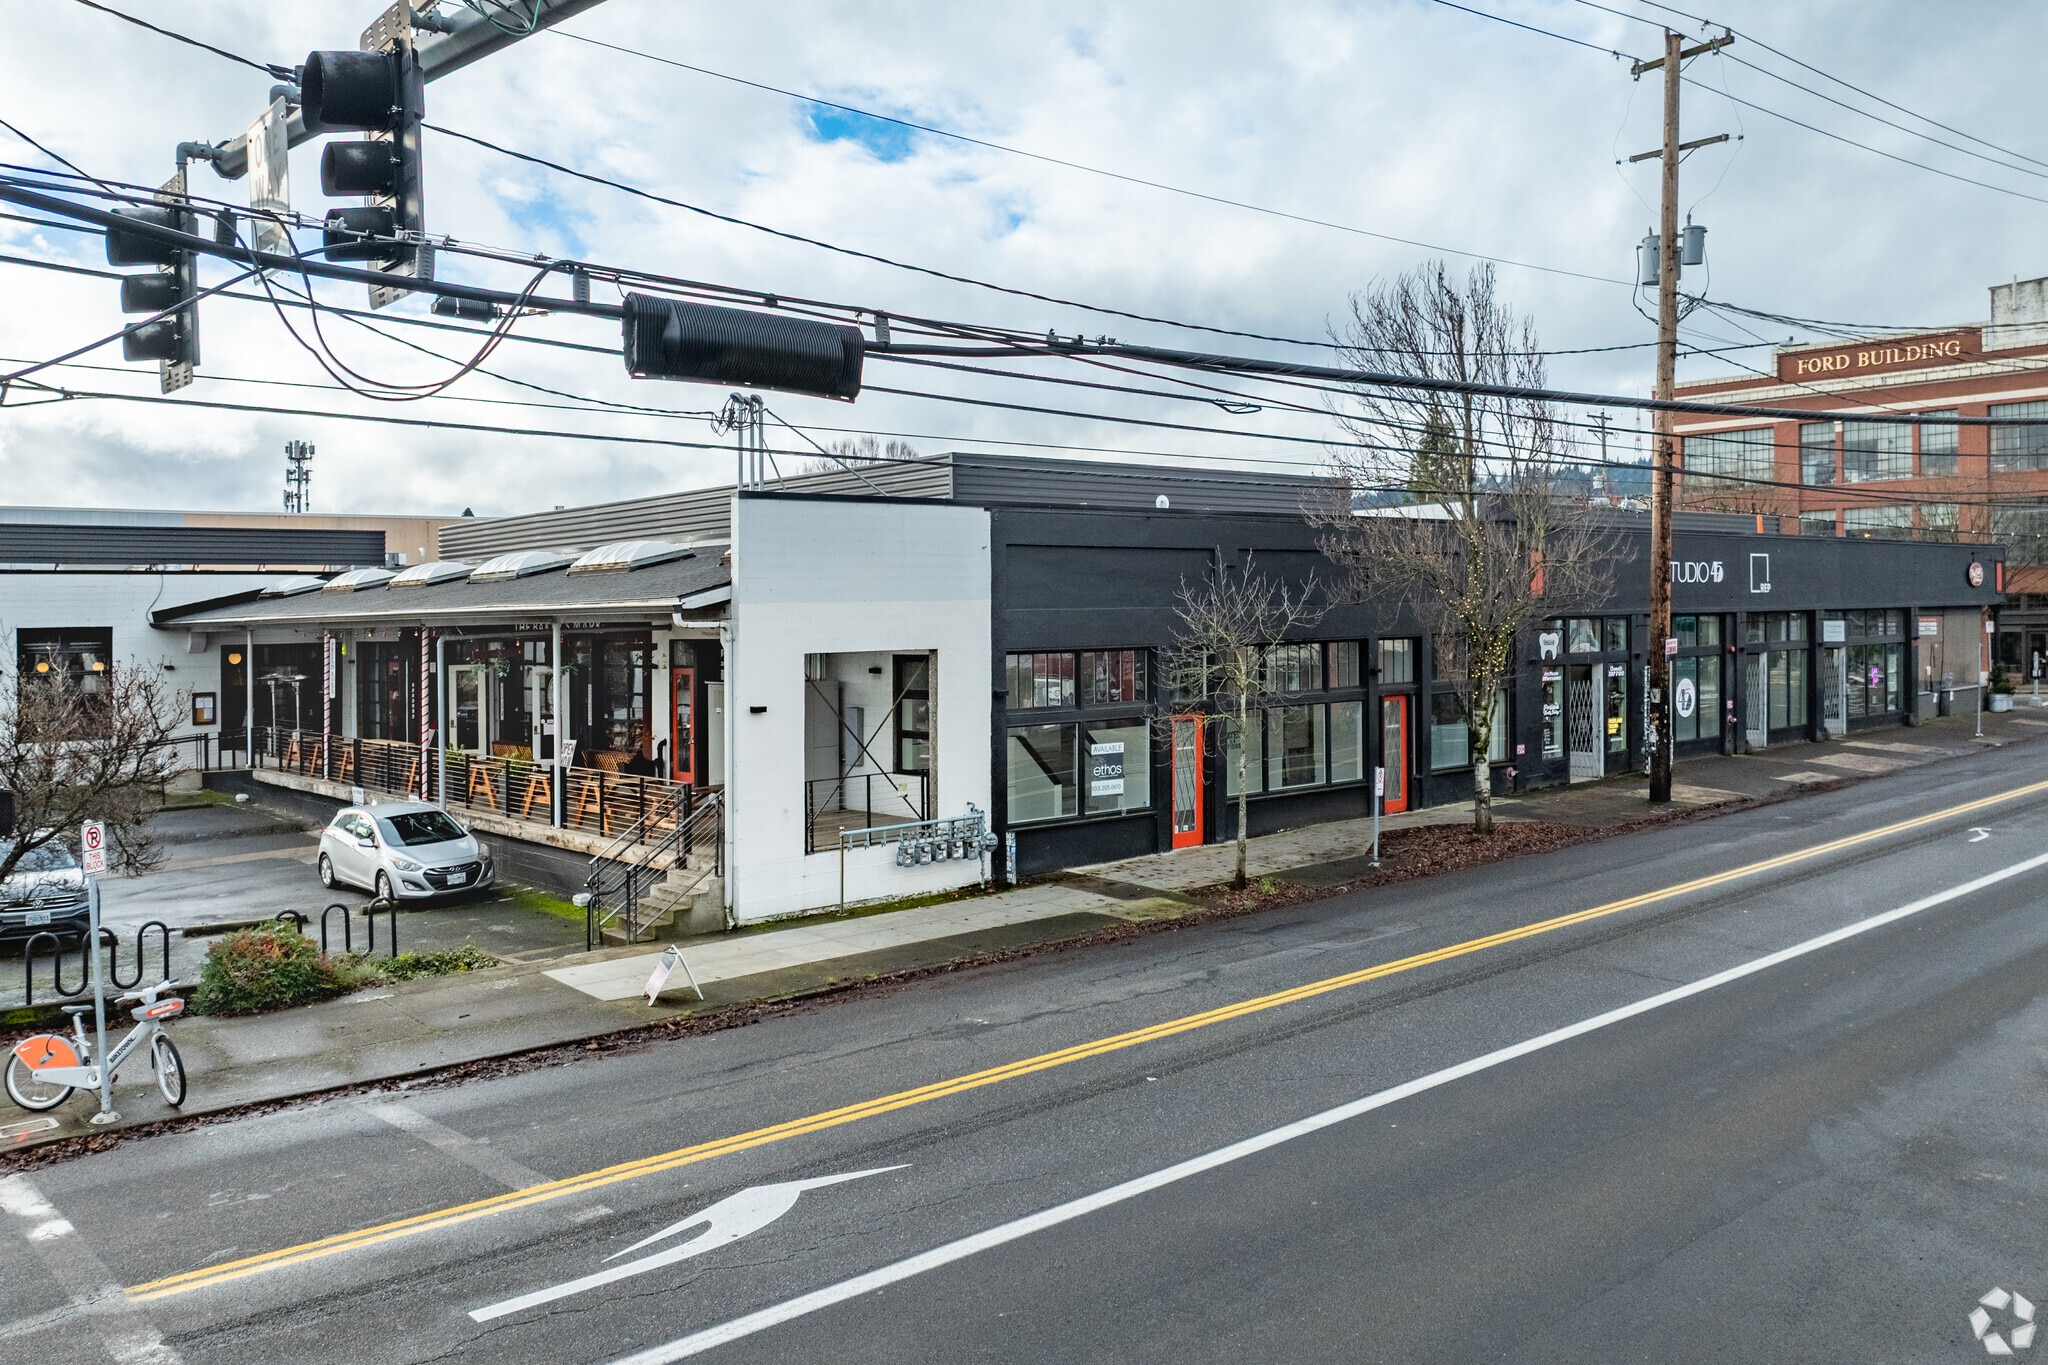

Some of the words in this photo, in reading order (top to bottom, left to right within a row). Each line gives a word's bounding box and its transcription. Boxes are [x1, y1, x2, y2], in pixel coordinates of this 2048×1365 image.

[255, 120, 278, 168] ONE
[256, 161, 281, 208] WAY
[1797, 354, 1850, 374] FORD
[1857, 340, 1961, 367] BUILDING
[1670, 561, 1709, 583] TUDIO
[1760, 583, 1772, 593] REP
[1093, 744, 1122, 752] AVAILABLE
[1093, 763, 1122, 776] ethos
[88, 852, 101, 860] THIS
[86, 860, 103, 870] BLOCK
[109, 1036, 136, 1063] BIKETOWN
